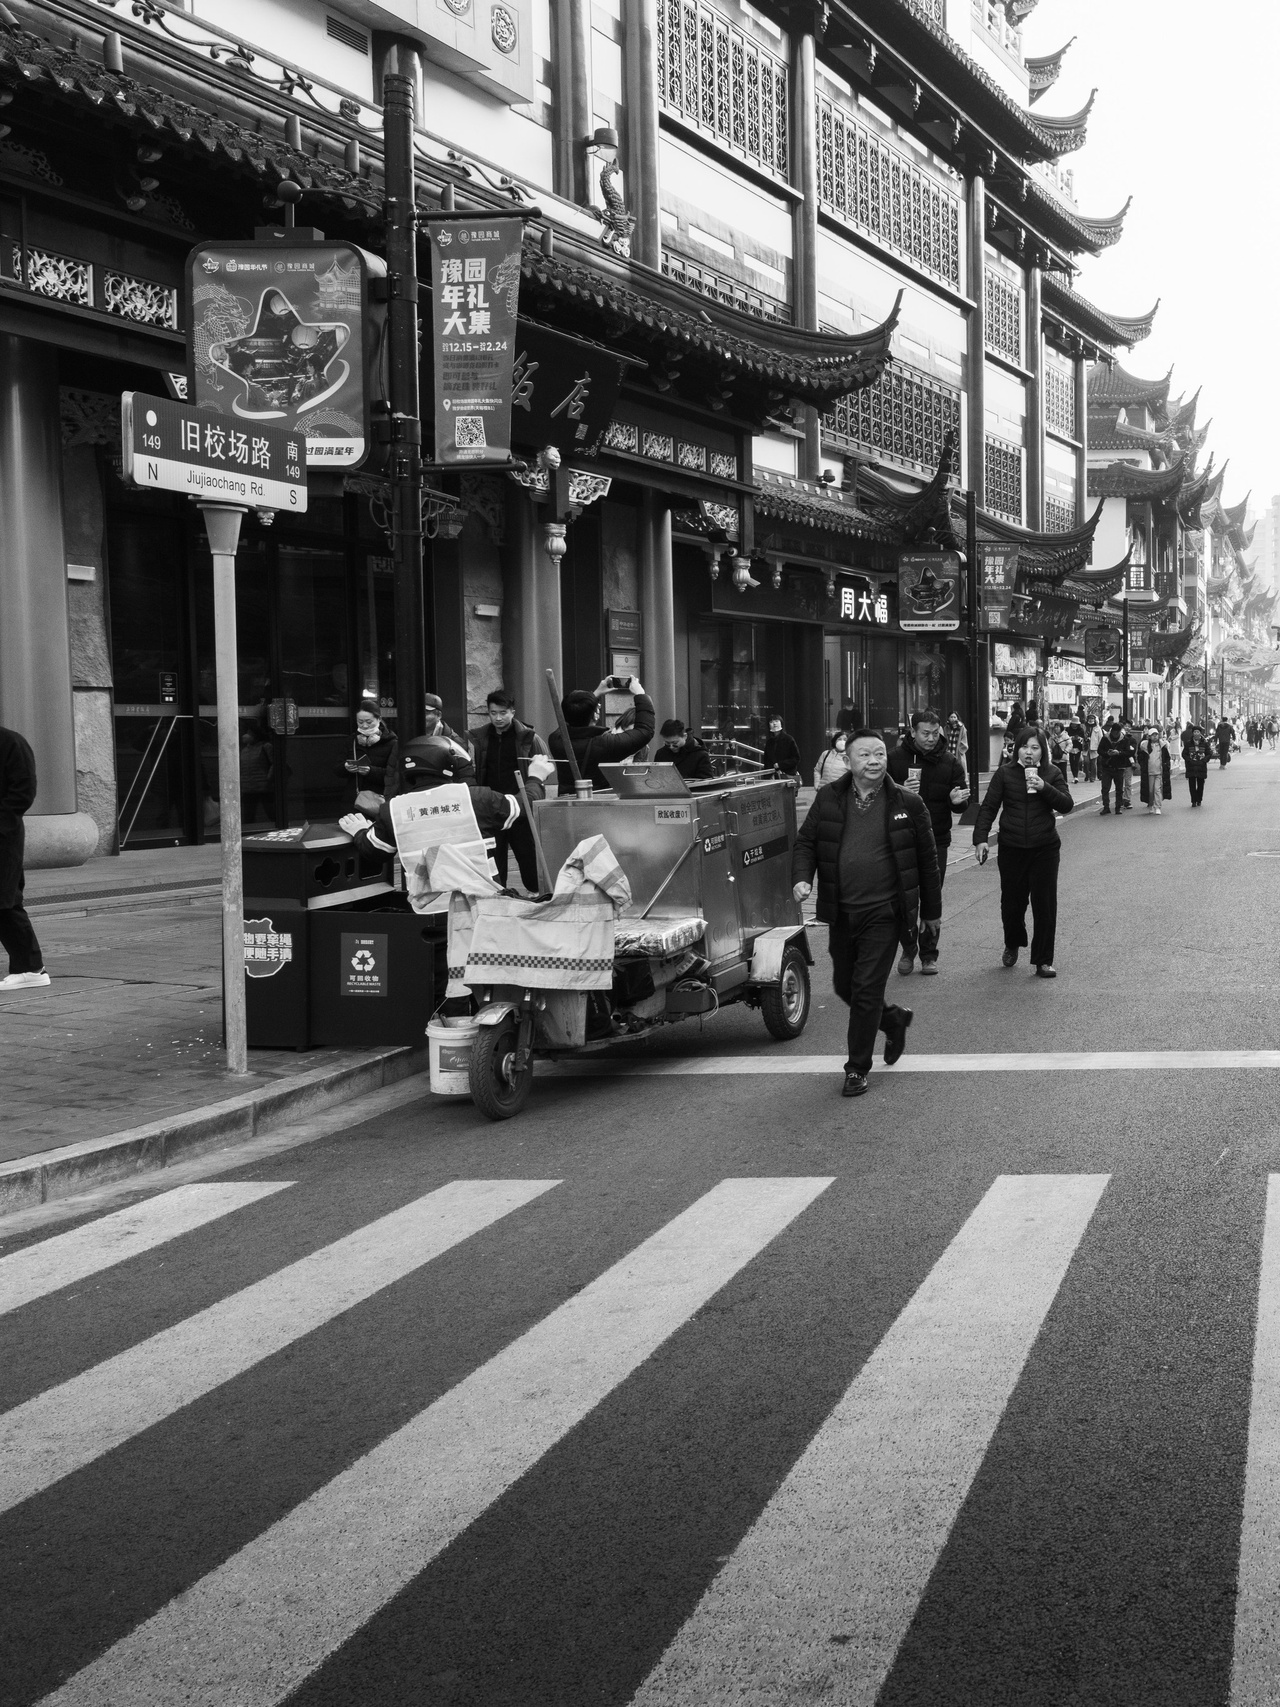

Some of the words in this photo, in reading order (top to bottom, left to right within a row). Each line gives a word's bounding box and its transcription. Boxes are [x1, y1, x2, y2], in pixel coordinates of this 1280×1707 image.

[440, 257, 487, 283] 豫园
[441, 283, 490, 309] 年礼
[441, 310, 491, 335] 大集
[142, 433, 161, 450] 149
[180, 419, 271, 470] 旧校场路
[287, 441, 299, 462] 南
[148, 462, 158, 481] N
[285, 464, 301, 480] 149
[186, 470, 246, 495] Jiujiaochang
[250, 480, 266, 497] Rd.
[289, 489, 297, 505] S
[841, 587, 888, 623] 周大福
[349, 974, 379, 982] 可回收物
